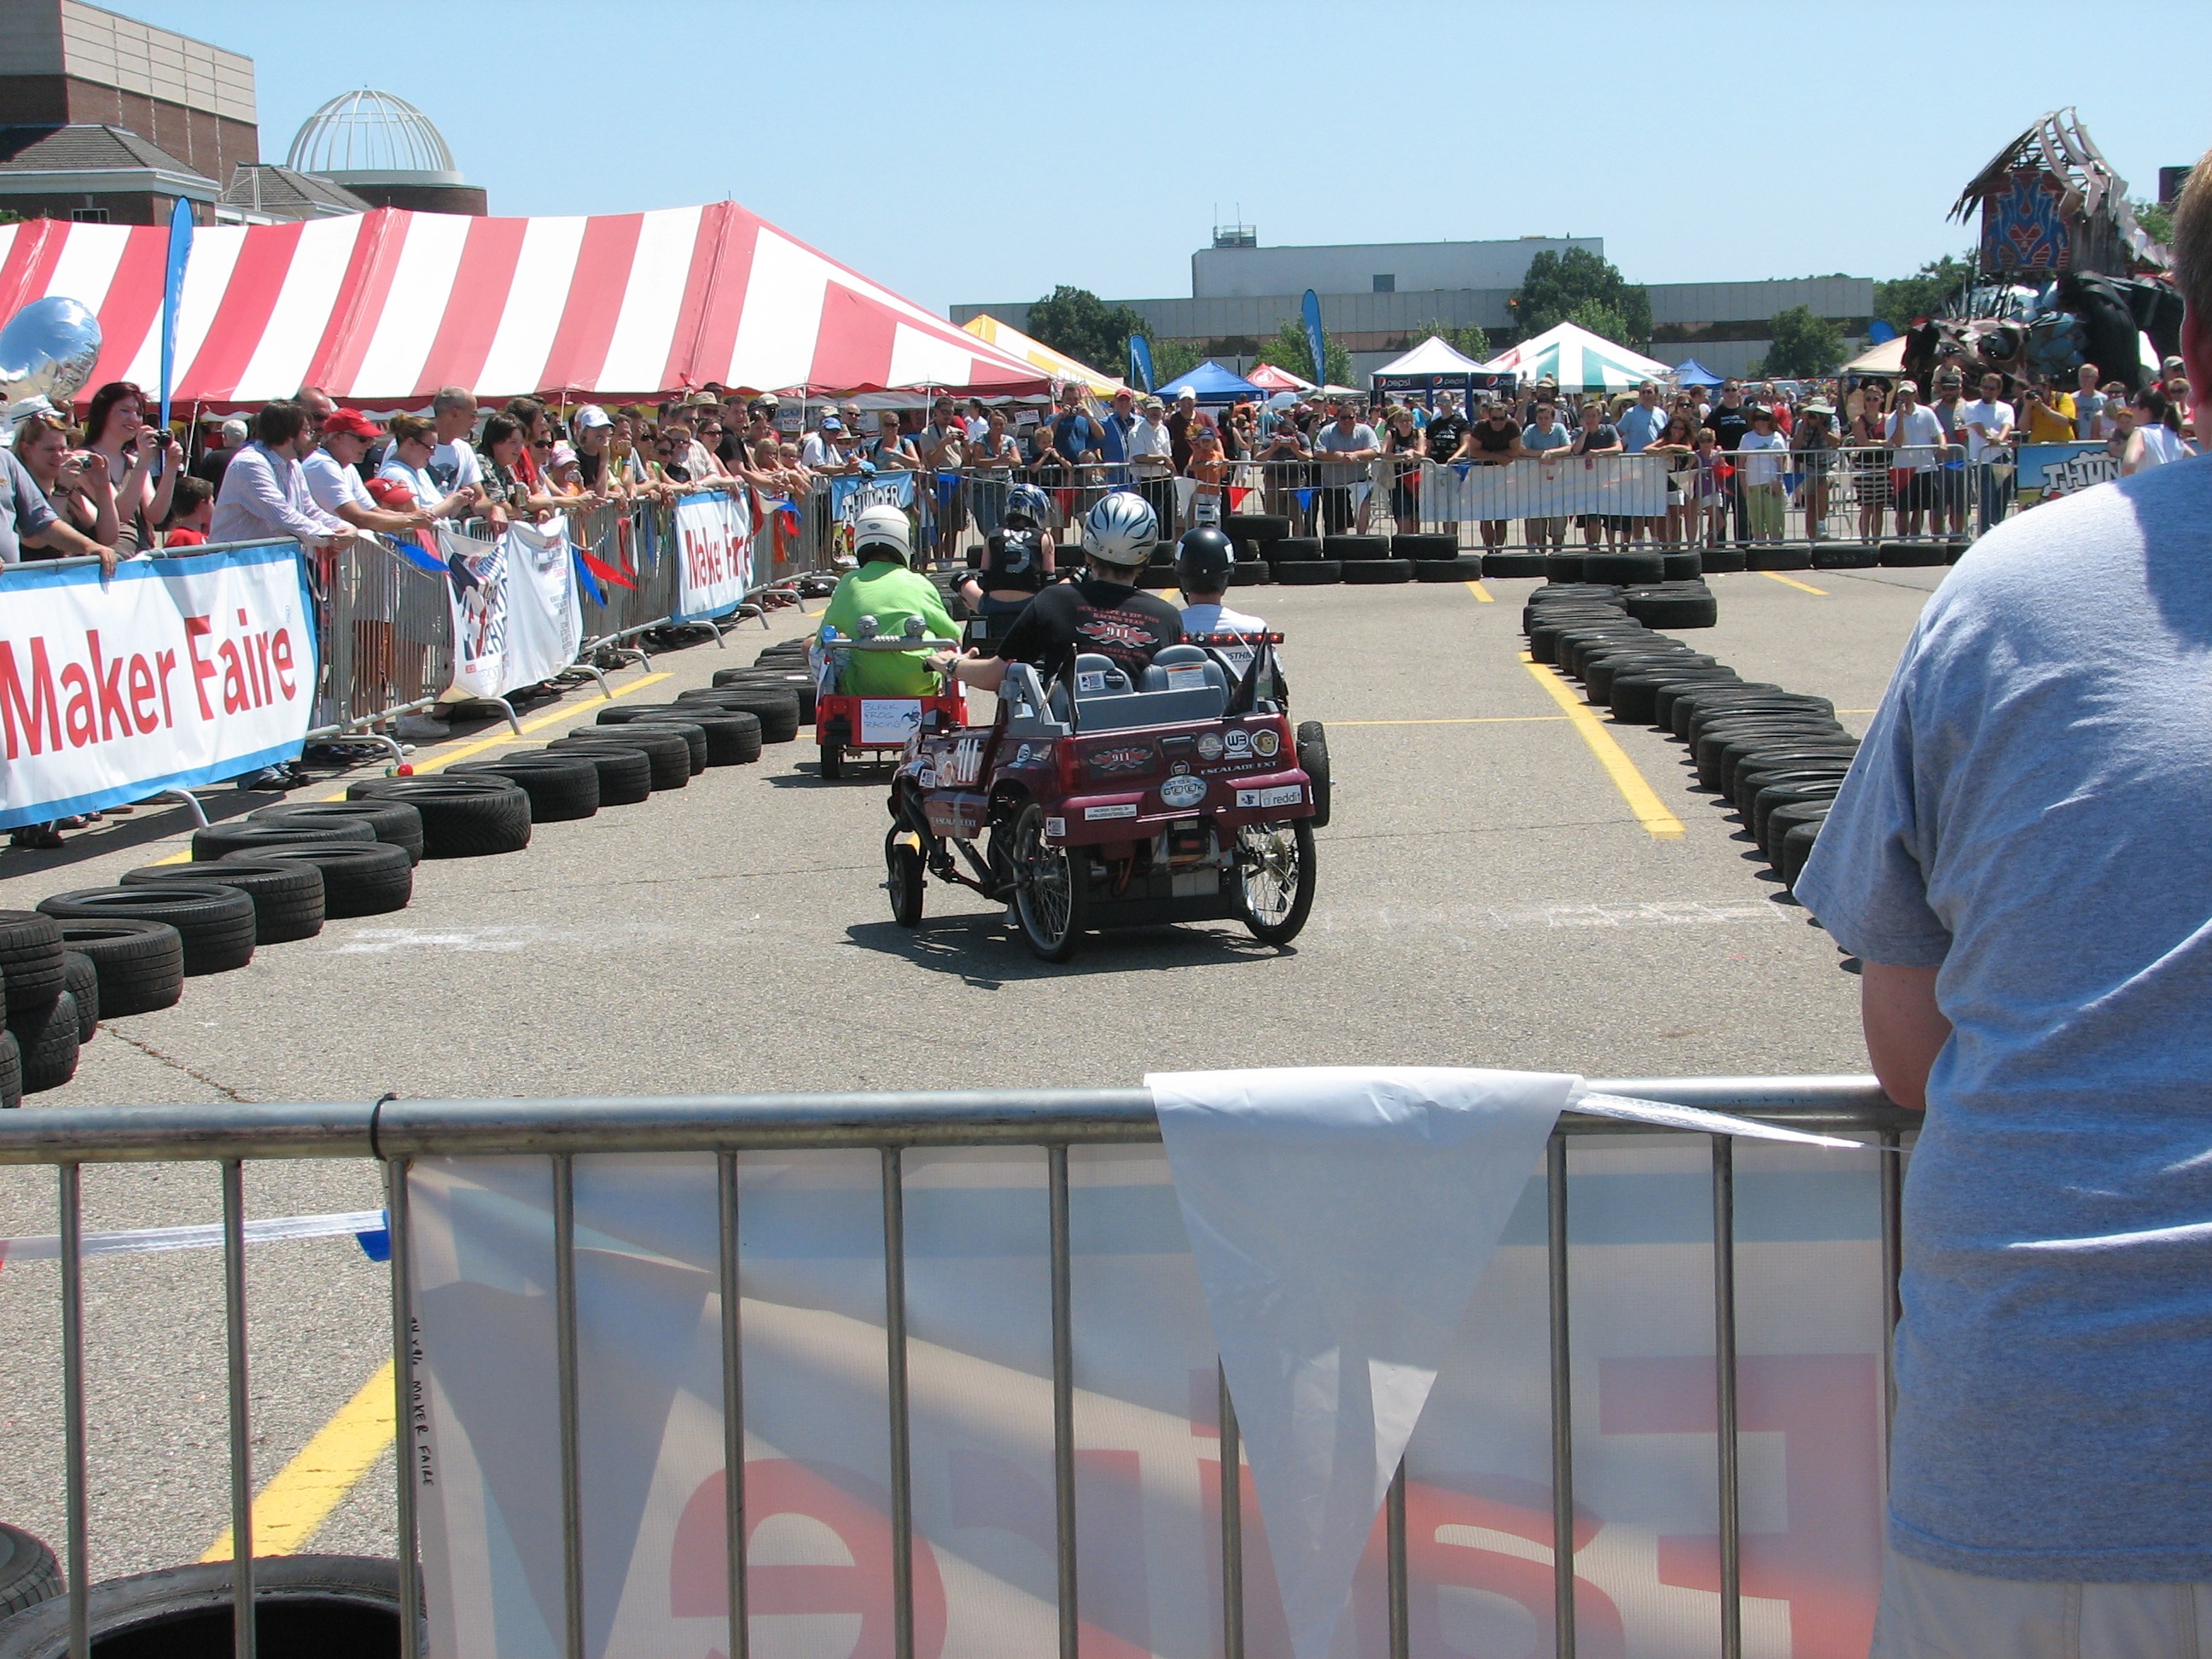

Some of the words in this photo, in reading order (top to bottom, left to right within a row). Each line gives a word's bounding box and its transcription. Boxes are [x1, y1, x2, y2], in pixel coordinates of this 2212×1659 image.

[1387, 377, 1411, 388] pepsi
[1444, 376, 1466, 386] pepsi
[842, 484, 902, 521] THUNDER
[1092, 612, 1122, 622] RACING
[1106, 626, 1129, 638] 911
[0, 629, 176, 761] Maker
[185, 609, 296, 722] Faire
[863, 702, 899, 711] BLACK
[1112, 752, 1130, 762] 911
[1201, 764, 1254, 775] ESCALADE
[1163, 783, 1204, 796] GEEK
[1273, 792, 1301, 805] reddit
[412, 1380, 429, 1437] MAKER
[418, 1445, 434, 1487] FAIRE
